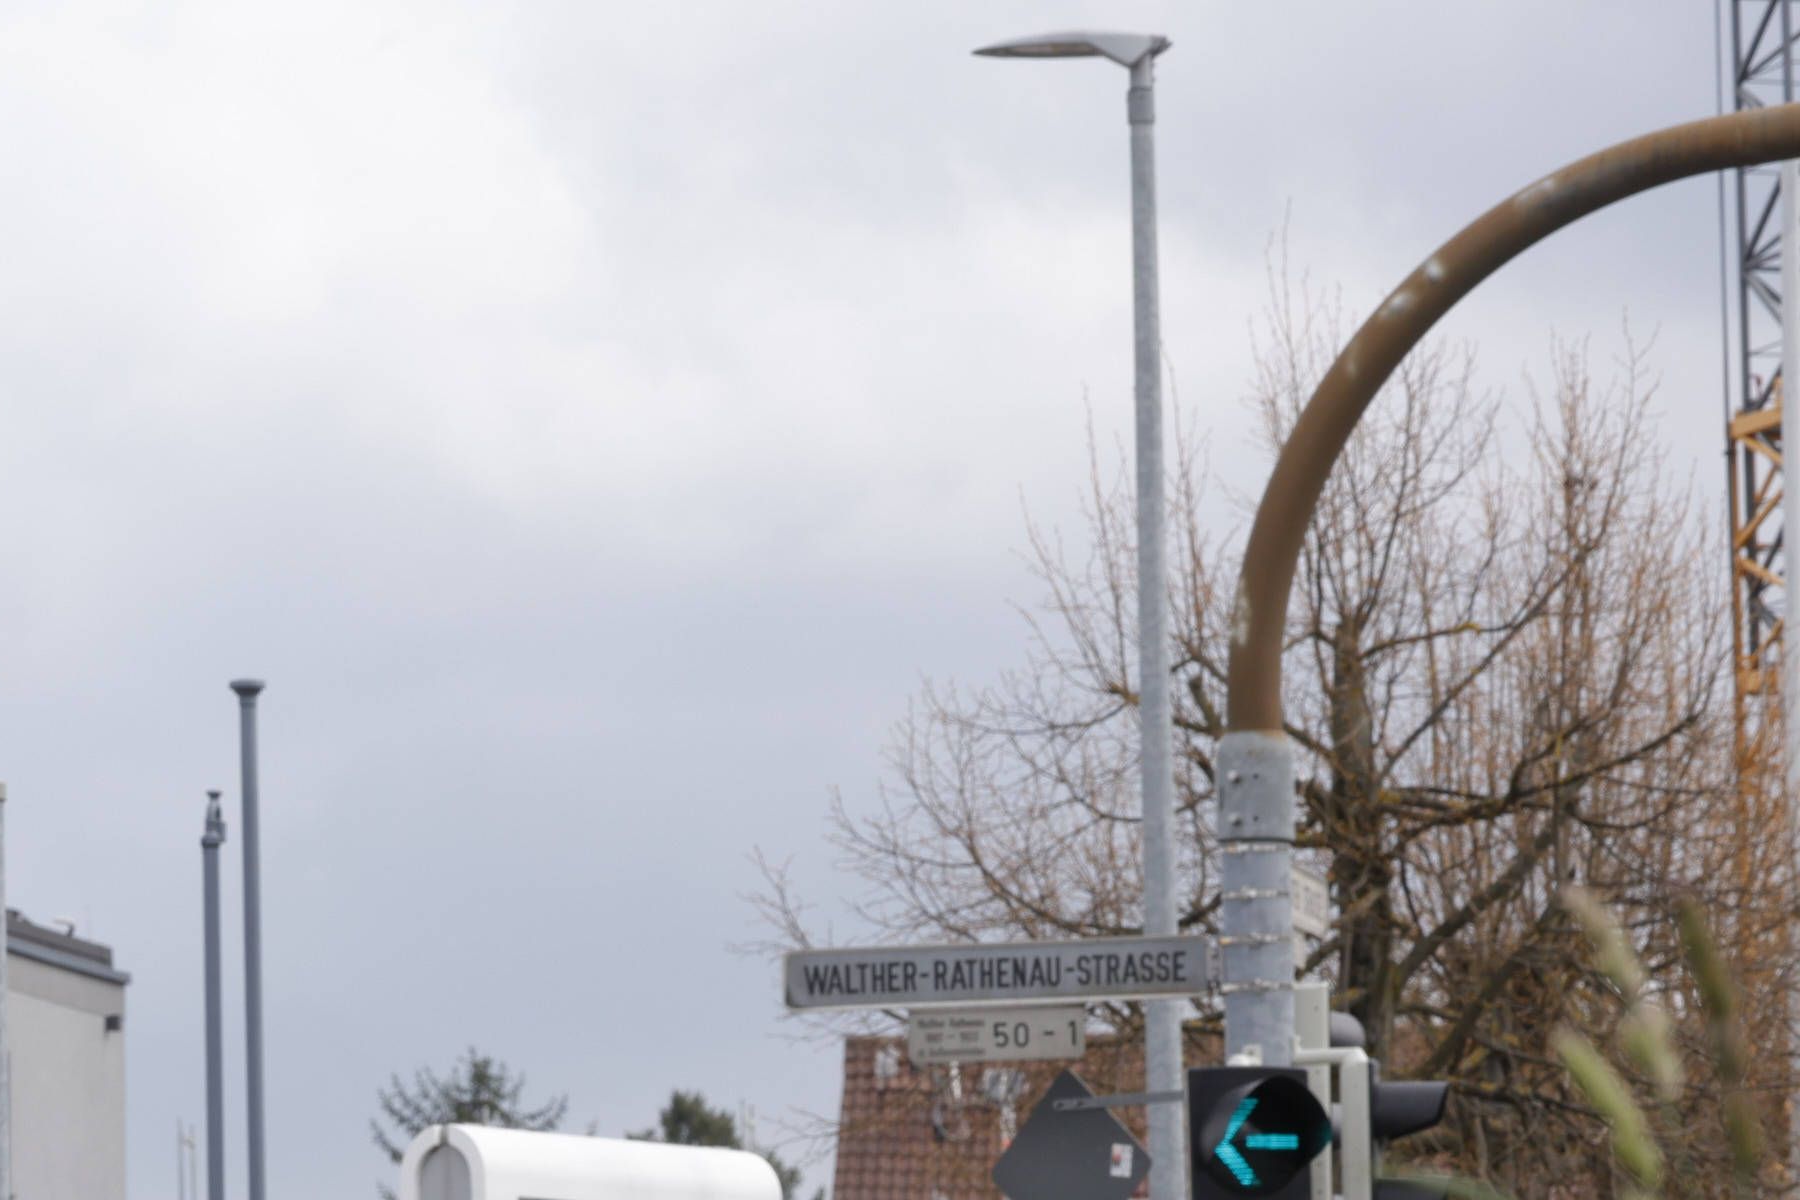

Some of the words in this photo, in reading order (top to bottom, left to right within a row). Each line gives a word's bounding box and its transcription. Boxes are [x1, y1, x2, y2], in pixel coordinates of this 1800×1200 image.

[803, 951, 1188, 995] WALTHER-RATHENAU-STRASSE
[992, 1021, 1030, 1048] 50
[1067, 1019, 1078, 1047] 1
